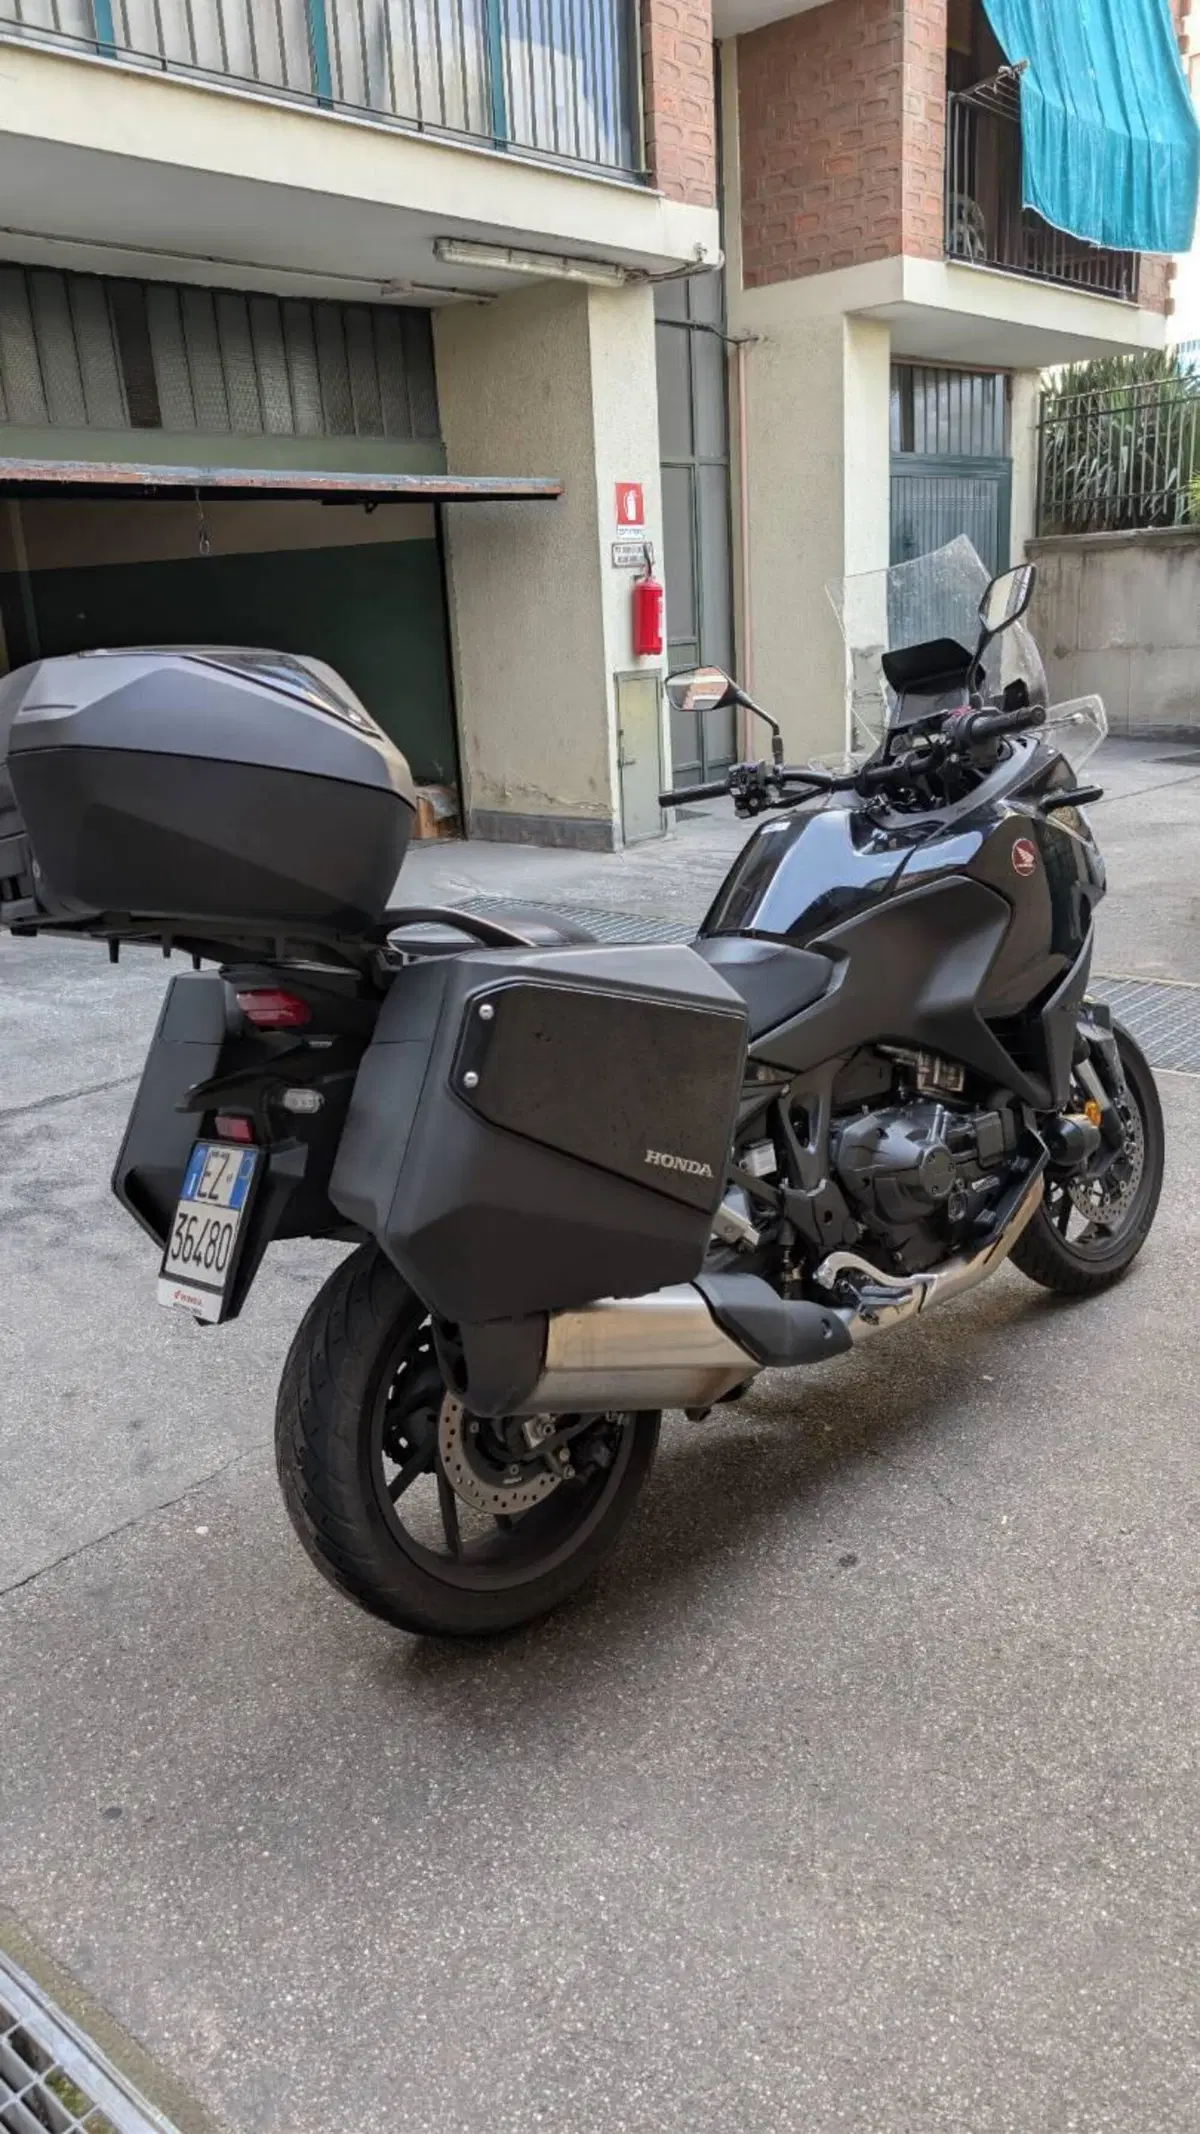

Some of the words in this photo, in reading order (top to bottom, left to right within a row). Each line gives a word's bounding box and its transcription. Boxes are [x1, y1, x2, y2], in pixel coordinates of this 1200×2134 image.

[197, 1151, 231, 1199] EZ
[644, 1150, 713, 1178] HONDA
[171, 1212, 232, 1272] 36480
